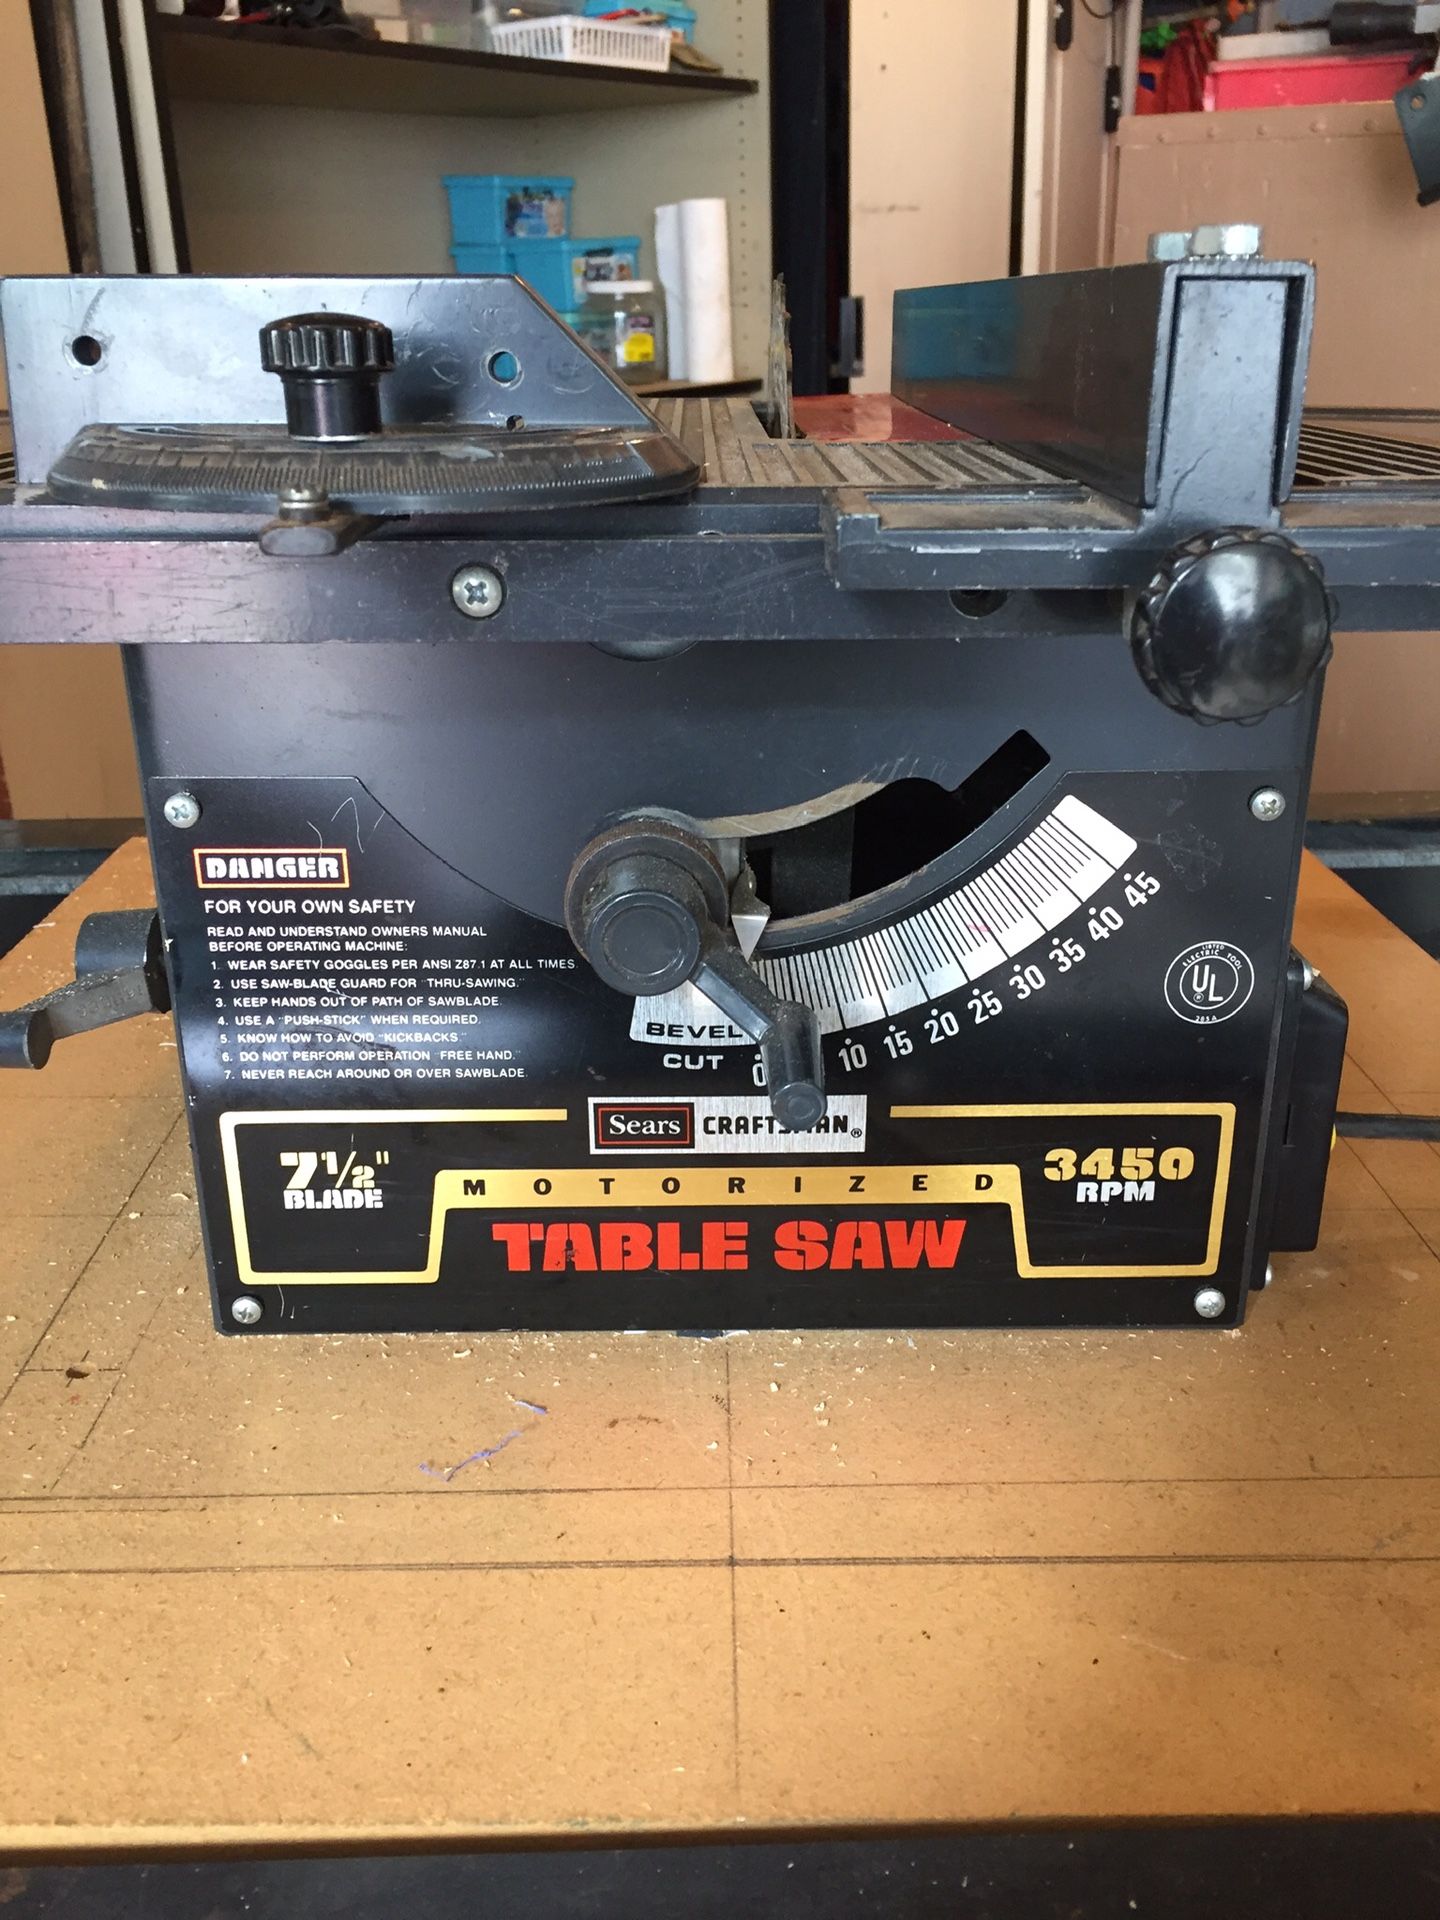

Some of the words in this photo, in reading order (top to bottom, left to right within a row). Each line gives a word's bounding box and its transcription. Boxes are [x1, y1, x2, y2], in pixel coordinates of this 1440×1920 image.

[206, 857, 339, 879] DANGER
[204, 899, 241, 914] FOR
[246, 899, 296, 914] YOUR
[301, 900, 343, 914] OWN
[349, 900, 416, 914] SAFETY
[207, 926, 243, 937] READ
[248, 926, 275, 937] AND
[279, 926, 367, 937] UNDERSTAND
[371, 926, 428, 937] OWNERS
[432, 926, 487, 937] MANUAL
[209, 941, 262, 952] BEFORE
[266, 941, 341, 952] OPERATING
[345, 941, 408, 951] MACHINE:
[227, 960, 267, 970] WEAR
[270, 960, 320, 970] SAFETY
[323, 960, 388, 970] GOGGLES
[392, 959, 418, 969] PER
[422, 959, 451, 969] ANSI
[455, 959, 486, 969] Z87.1
[489, 959, 504, 969] AT
[509, 959, 533, 969] ALL
[1182, 949, 1220, 967] ELECTRIC
[1226, 953, 1243, 970] TOOL
[838, 1044, 868, 1072] 10
[883, 1030, 913, 1059] 15
[924, 1011, 960, 1045] 20
[967, 990, 1003, 1024] 25
[1009, 964, 1046, 1000] 30
[1048, 938, 1086, 973] 35
[1087, 906, 1124, 941] 40
[1123, 871, 1161, 907] 45
[213, 979, 224, 989] 2.
[231, 979, 258, 989] USE
[261, 979, 336, 989] SAW-BLADE
[340, 979, 386, 989] GUARD
[390, 978, 417, 988] FOR
[1192, 964, 1224, 1002] UL
[215, 998, 227, 1008] 3.
[233, 998, 268, 1008] KEEP
[271, 997, 317, 1007] HANDS
[320, 997, 347, 1007] OUT
[350, 997, 367, 1007] OF
[371, 997, 403, 1007] PATH
[407, 997, 423, 1007] OF
[217, 1016, 228, 1026] 4.
[235, 1016, 262, 1026] USE
[265, 1016, 275, 1026] A
[371, 1015, 409, 1025] WHEN
[412, 1014, 481, 1025] REQUIRED.
[220, 1034, 231, 1044] 5.
[237, 1034, 277, 1044] KNOW
[281, 1033, 311, 1043] HOW
[315, 1033, 333, 1043] TO
[336, 1033, 374, 1043] AVOID
[646, 1022, 743, 1039] BEVEL
[222, 1052, 233, 1062] 6.
[239, 1052, 259, 1062] DO
[262, 1052, 288, 1062] NOT
[293, 1051, 355, 1062] PERFORM
[359, 1051, 430, 1061] OPERATION
[663, 1053, 724, 1070] CUT
[224, 1070, 235, 1080] 7.
[241, 1070, 285, 1080] NEVER
[288, 1069, 332, 1079] REACH
[336, 1069, 390, 1079] AROUND
[394, 1069, 412, 1079] OR
[416, 1069, 451, 1079] OVER
[609, 1113, 681, 1136] Sears
[703, 1115, 848, 1135] CRAFTAN
[1043, 1146, 1195, 1182] 3450
[283, 1189, 383, 1209] BLADE
[1075, 1180, 1156, 1204] RPM
[492, 1221, 748, 1272] TABLE
[774, 1219, 966, 1271] SAW
